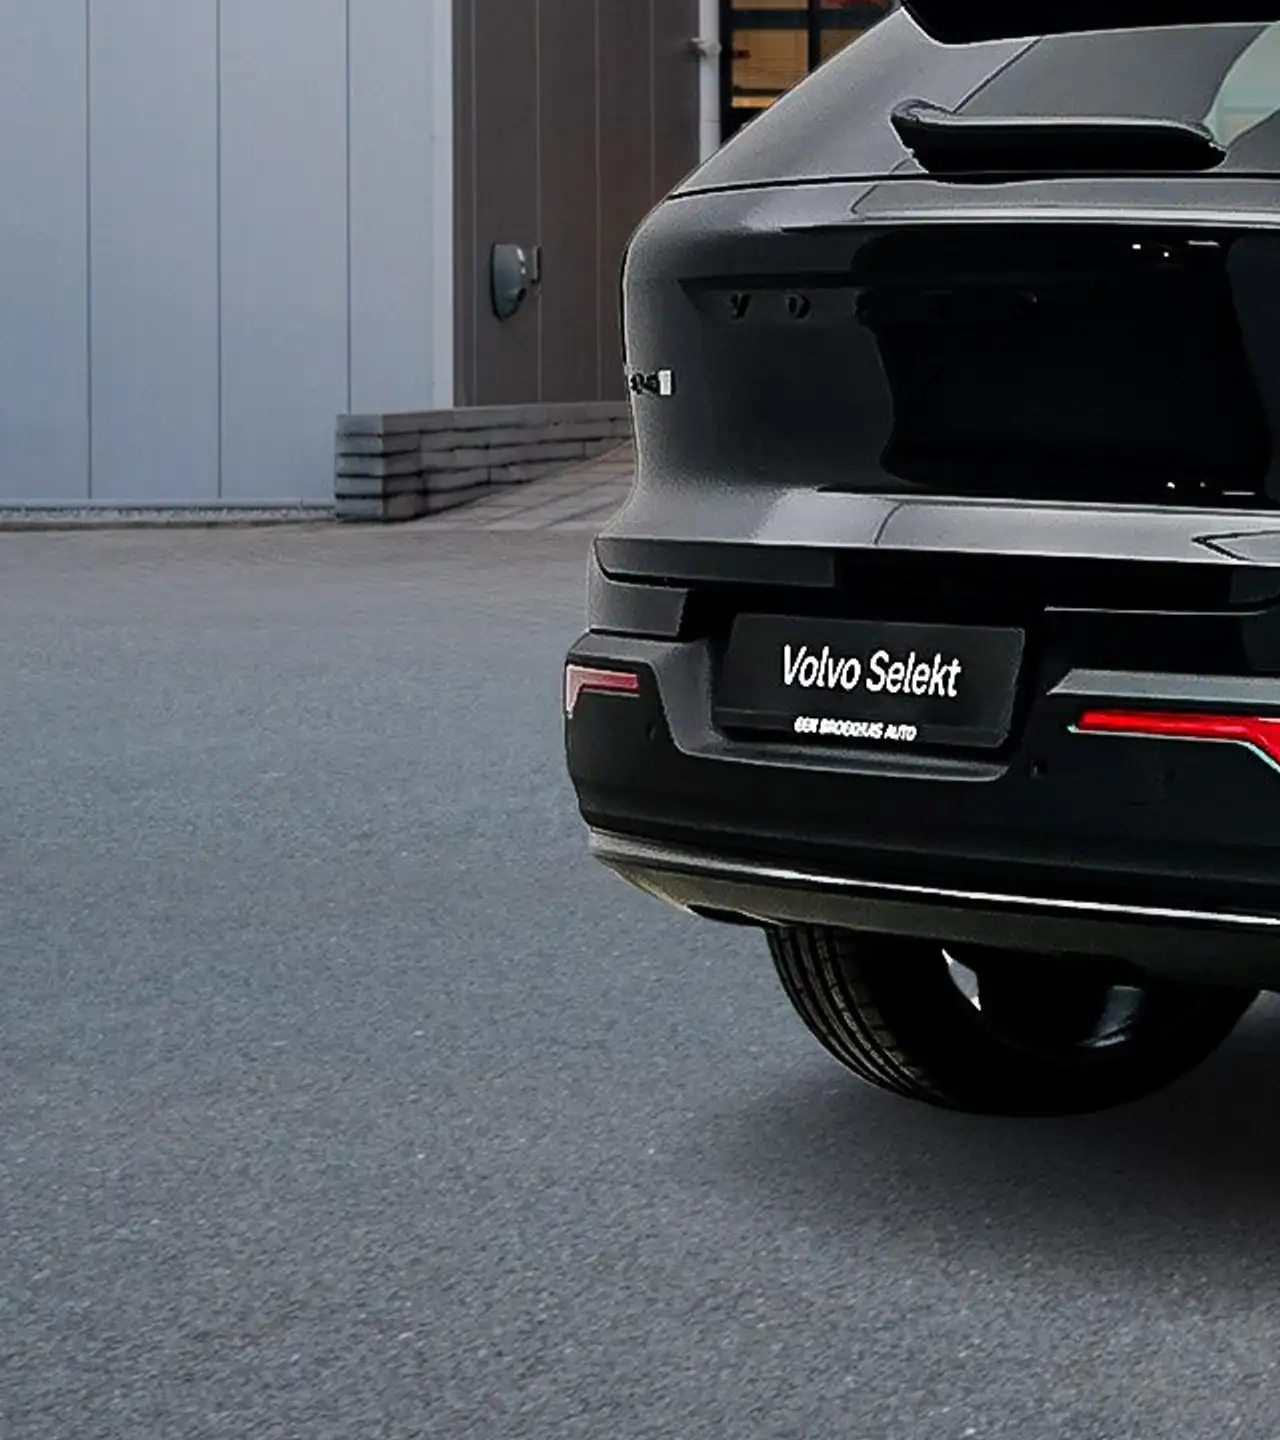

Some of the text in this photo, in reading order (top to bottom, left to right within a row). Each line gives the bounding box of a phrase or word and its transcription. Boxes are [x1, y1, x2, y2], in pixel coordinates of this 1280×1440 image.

[783, 644, 962, 697] Volvo Selekt
[884, 724, 917, 741] AUTO
